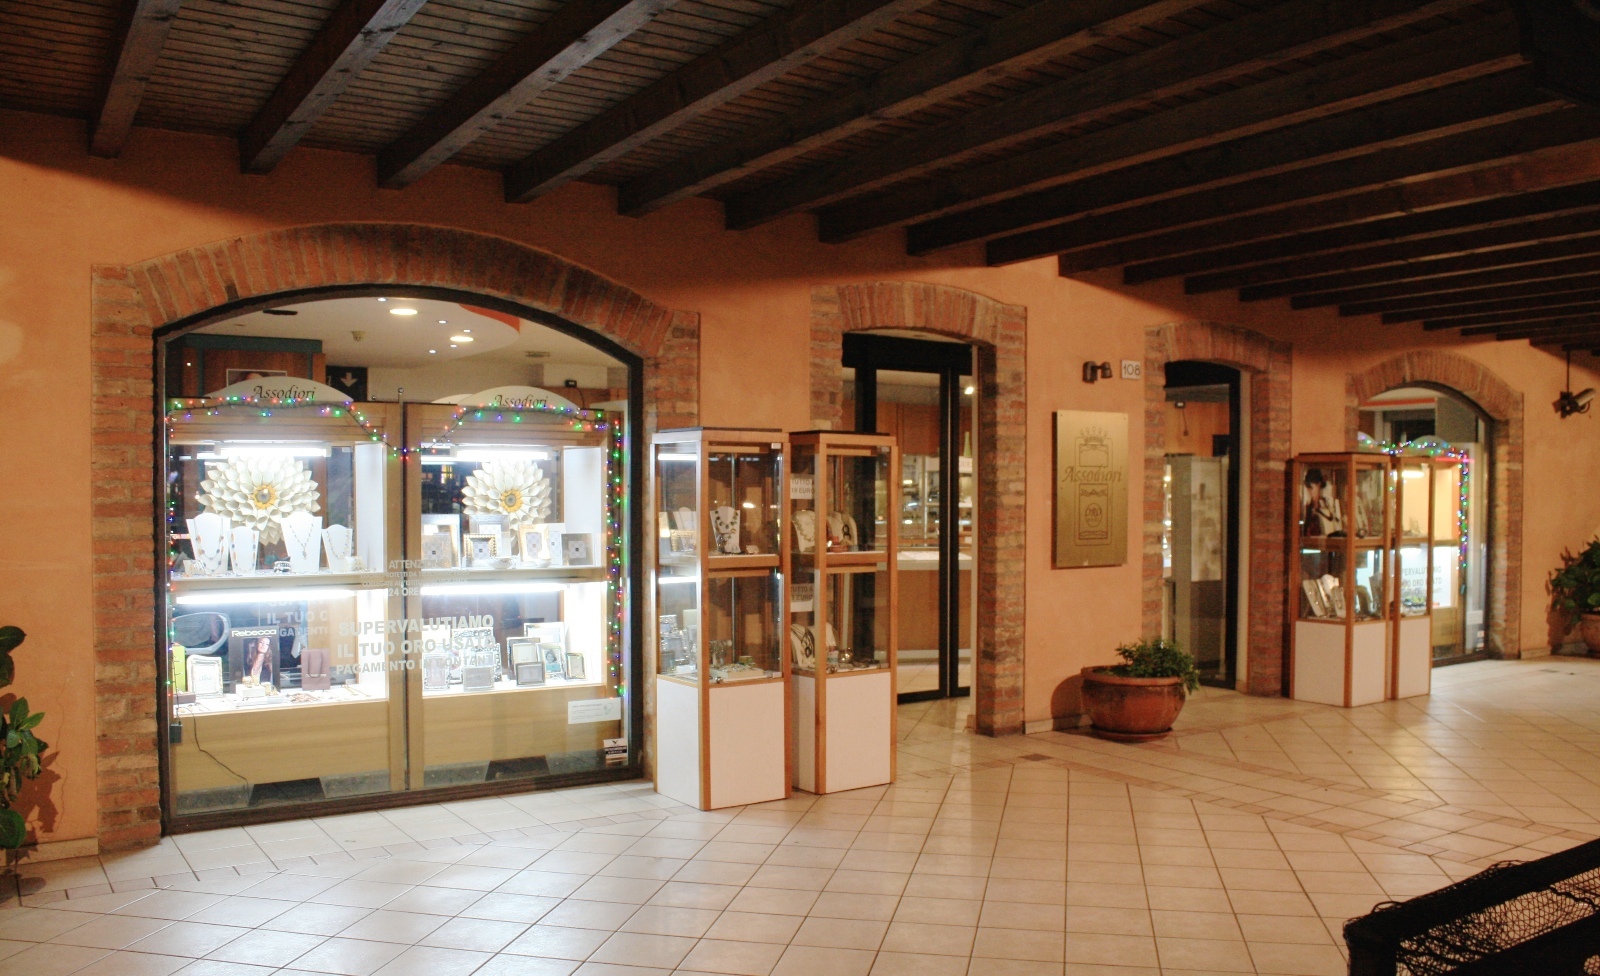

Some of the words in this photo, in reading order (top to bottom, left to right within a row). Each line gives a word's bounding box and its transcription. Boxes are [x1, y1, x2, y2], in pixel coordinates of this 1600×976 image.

[1123, 364, 1140, 376] 108
[251, 385, 316, 399] Assodiori
[495, 394, 549, 408] Assodiori
[1061, 465, 1122, 483] Assodiori
[388, 588, 400, 597] 24
[401, 587, 419, 597] ORE
[231, 629, 277, 637] Rebecca
[338, 615, 494, 637] SUPERVALUTIAMO
[337, 643, 354, 659] IL
[359, 641, 395, 657] TUO
[400, 638, 436, 655] ORO
[442, 635, 496, 651] USATO
[335, 659, 416, 675] PAGAMENTO
